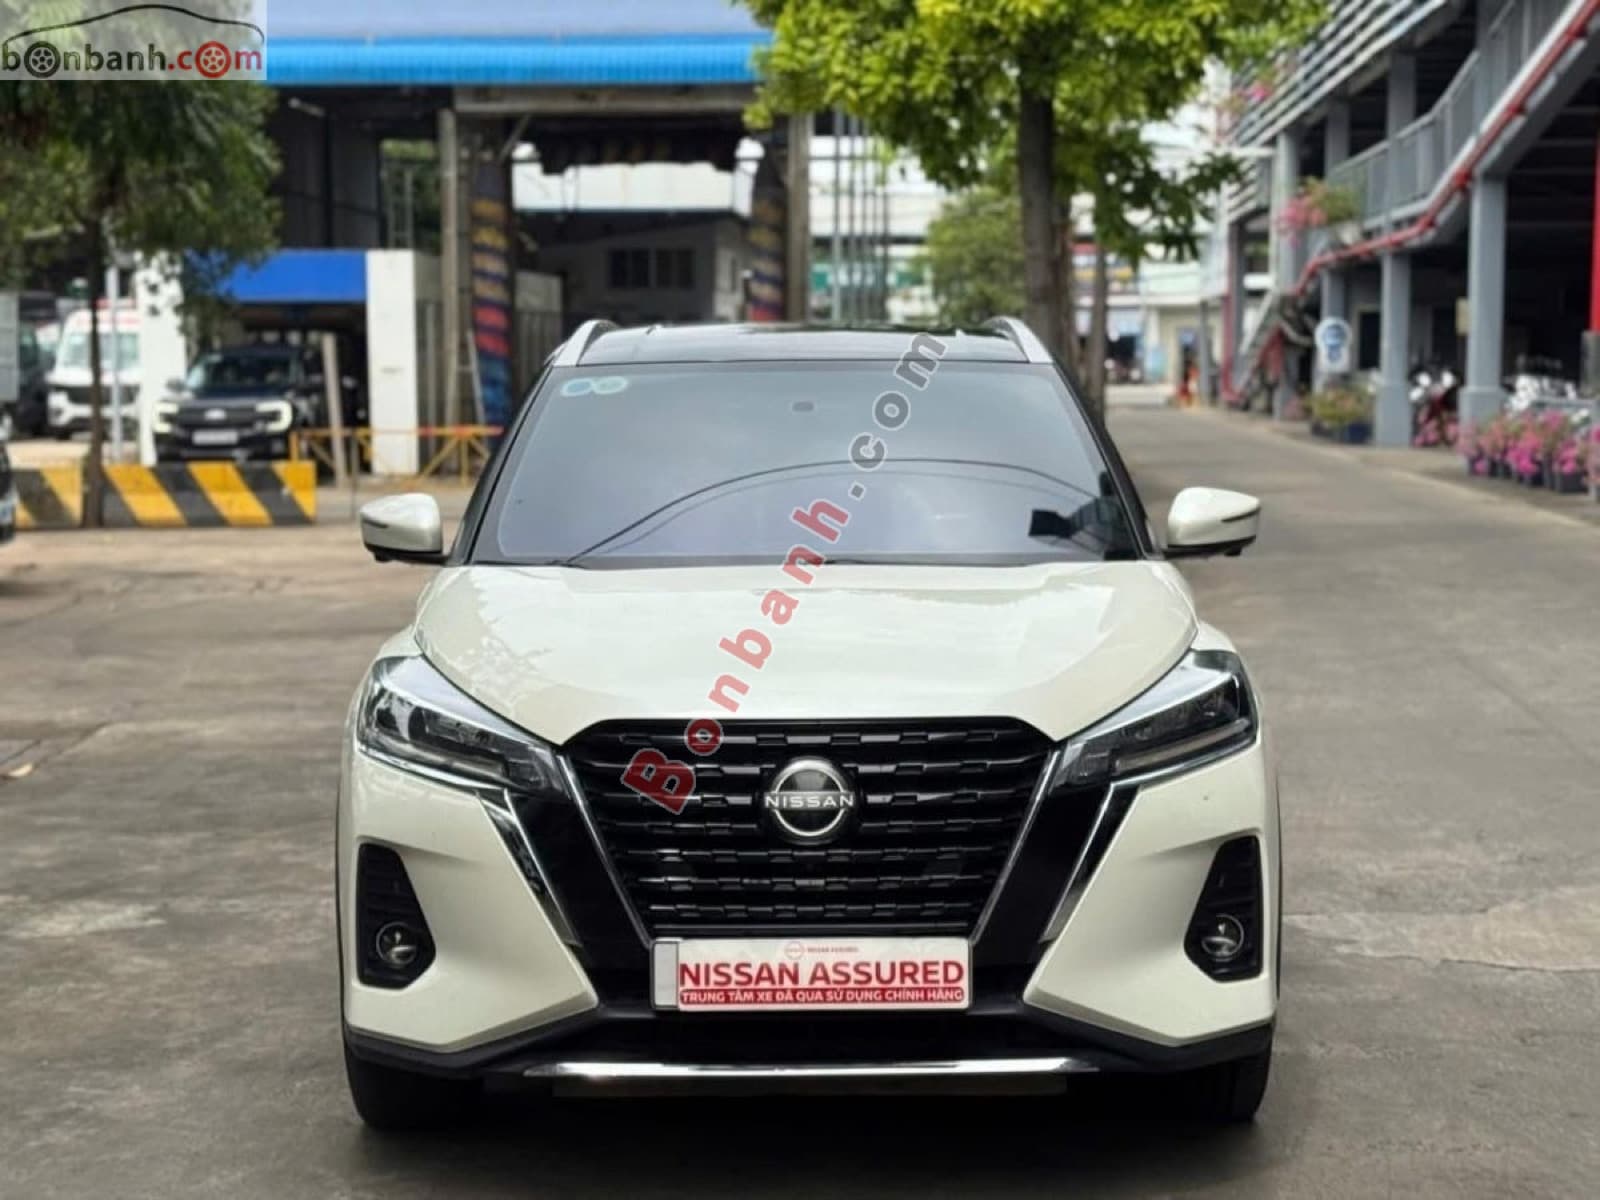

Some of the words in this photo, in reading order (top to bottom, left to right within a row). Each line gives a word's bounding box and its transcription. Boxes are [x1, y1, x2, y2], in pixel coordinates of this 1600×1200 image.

[764, 794, 854, 808] NISSAN
[680, 962, 799, 986] NISSAN
[808, 961, 964, 985] ASSURED
[682, 991, 725, 1003] TRUNG
[728, 988, 754, 1002] TÂM
[757, 990, 773, 1001] XE
[796, 990, 824, 1002] QUA
